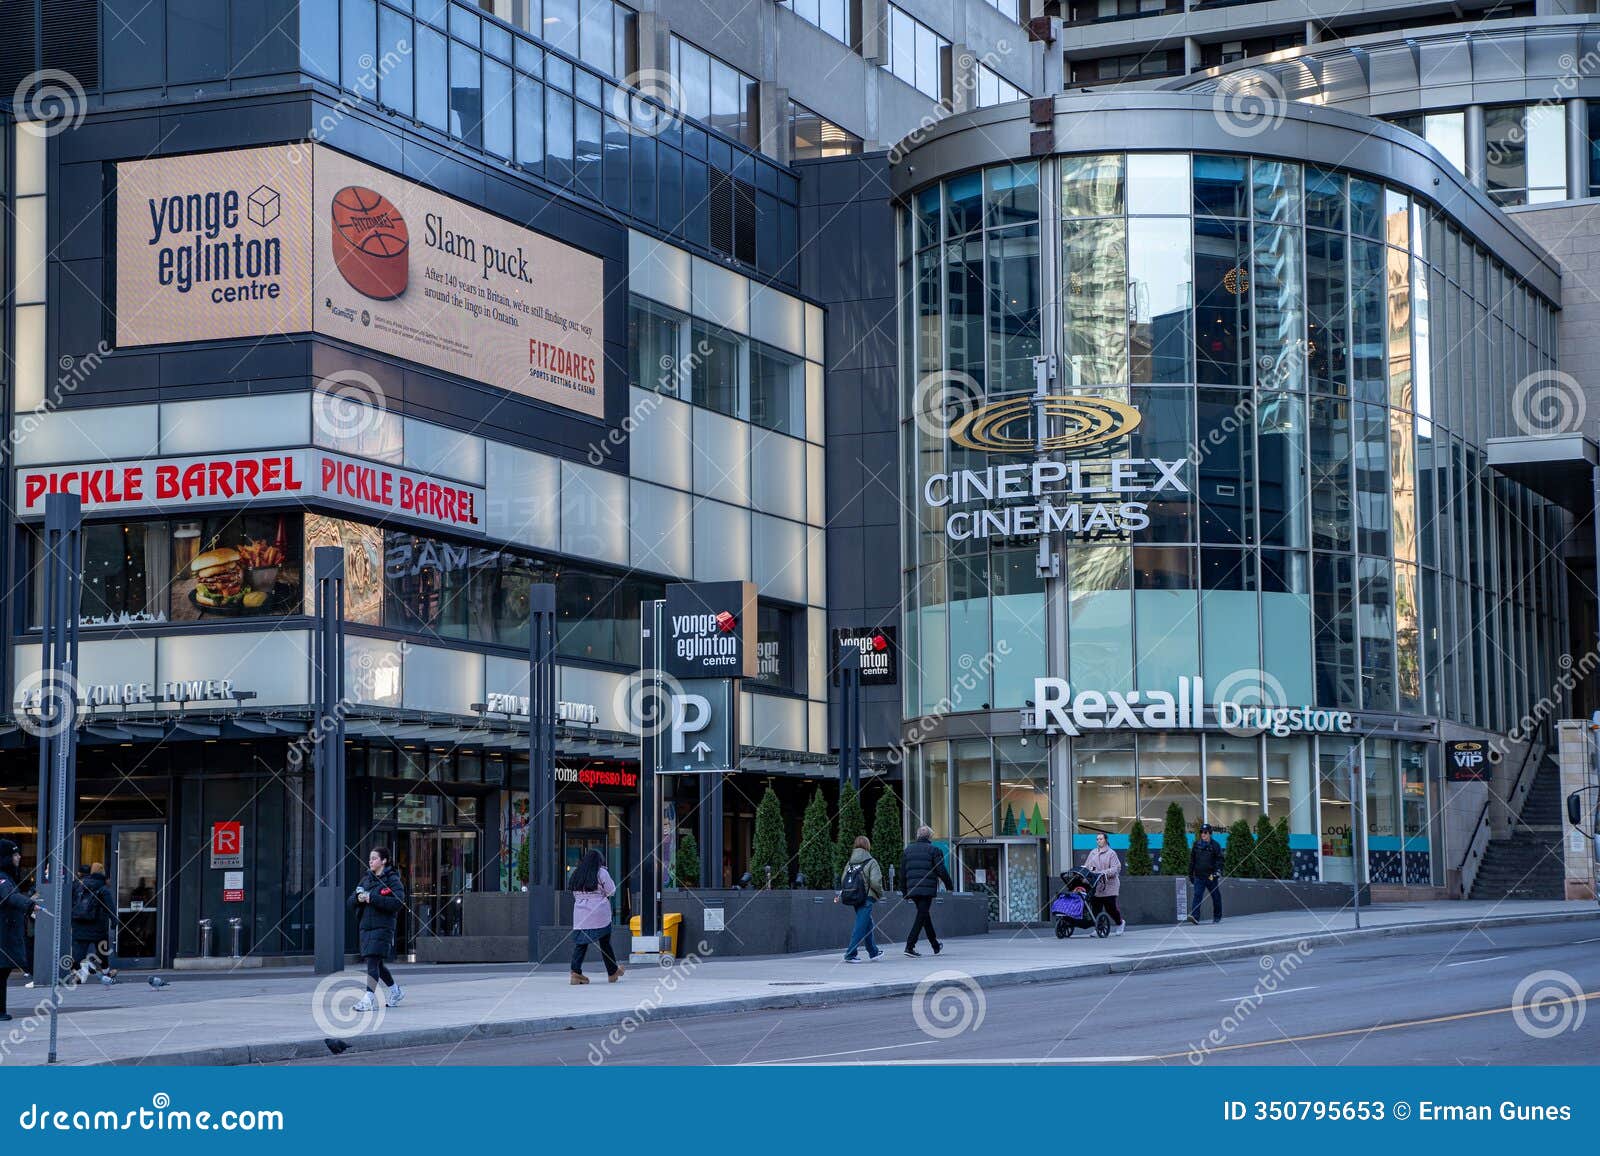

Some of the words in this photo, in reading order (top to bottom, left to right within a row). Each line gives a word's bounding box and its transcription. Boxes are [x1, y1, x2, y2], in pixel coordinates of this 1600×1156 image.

[148, 190, 239, 245] yonge
[158, 233, 281, 293] eglinton
[424, 213, 477, 263] Slam
[482, 244, 533, 284] puck.
[211, 280, 281, 303] centre
[424, 266, 443, 283] After
[445, 273, 457, 288] 140
[459, 280, 477, 295] years
[478, 284, 486, 298] in
[487, 288, 512, 309] Britain,
[513, 298, 530, 314] we're
[531, 305, 544, 319] still
[544, 308, 568, 332] finding
[569, 320, 579, 331] our
[424, 287, 450, 303] around
[451, 292, 463, 308] the
[464, 298, 483, 318] lingo
[484, 304, 491, 317] in
[529, 338, 595, 384] FITZDARES
[529, 367, 549, 382] SPORTS
[550, 374, 572, 390] BETTING
[572, 381, 577, 390] &
[577, 383, 596, 396] CASINO
[25, 468, 144, 508] PICKLE
[155, 456, 303, 500] BARREL
[321, 458, 394, 507] PICKLE
[399, 476, 479, 525] BARREL
[924, 457, 1189, 507] CINEPLEX
[946, 502, 1150, 541] CINEMAS
[672, 614, 717, 638] yonge
[677, 634, 736, 660] eglinton
[702, 656, 737, 666] centre
[860, 653, 888, 668] inton
[84, 682, 152, 706] YONGE
[163, 679, 234, 702] TOWER
[1033, 676, 1204, 737] Rexall
[1217, 700, 1353, 737] Drugstore
[671, 694, 712, 753] P
[554, 766, 578, 782] roma
[578, 769, 620, 788] espresso
[621, 768, 637, 787] bar
[1454, 755, 1483, 767] VIP
[218, 830, 235, 851] R
